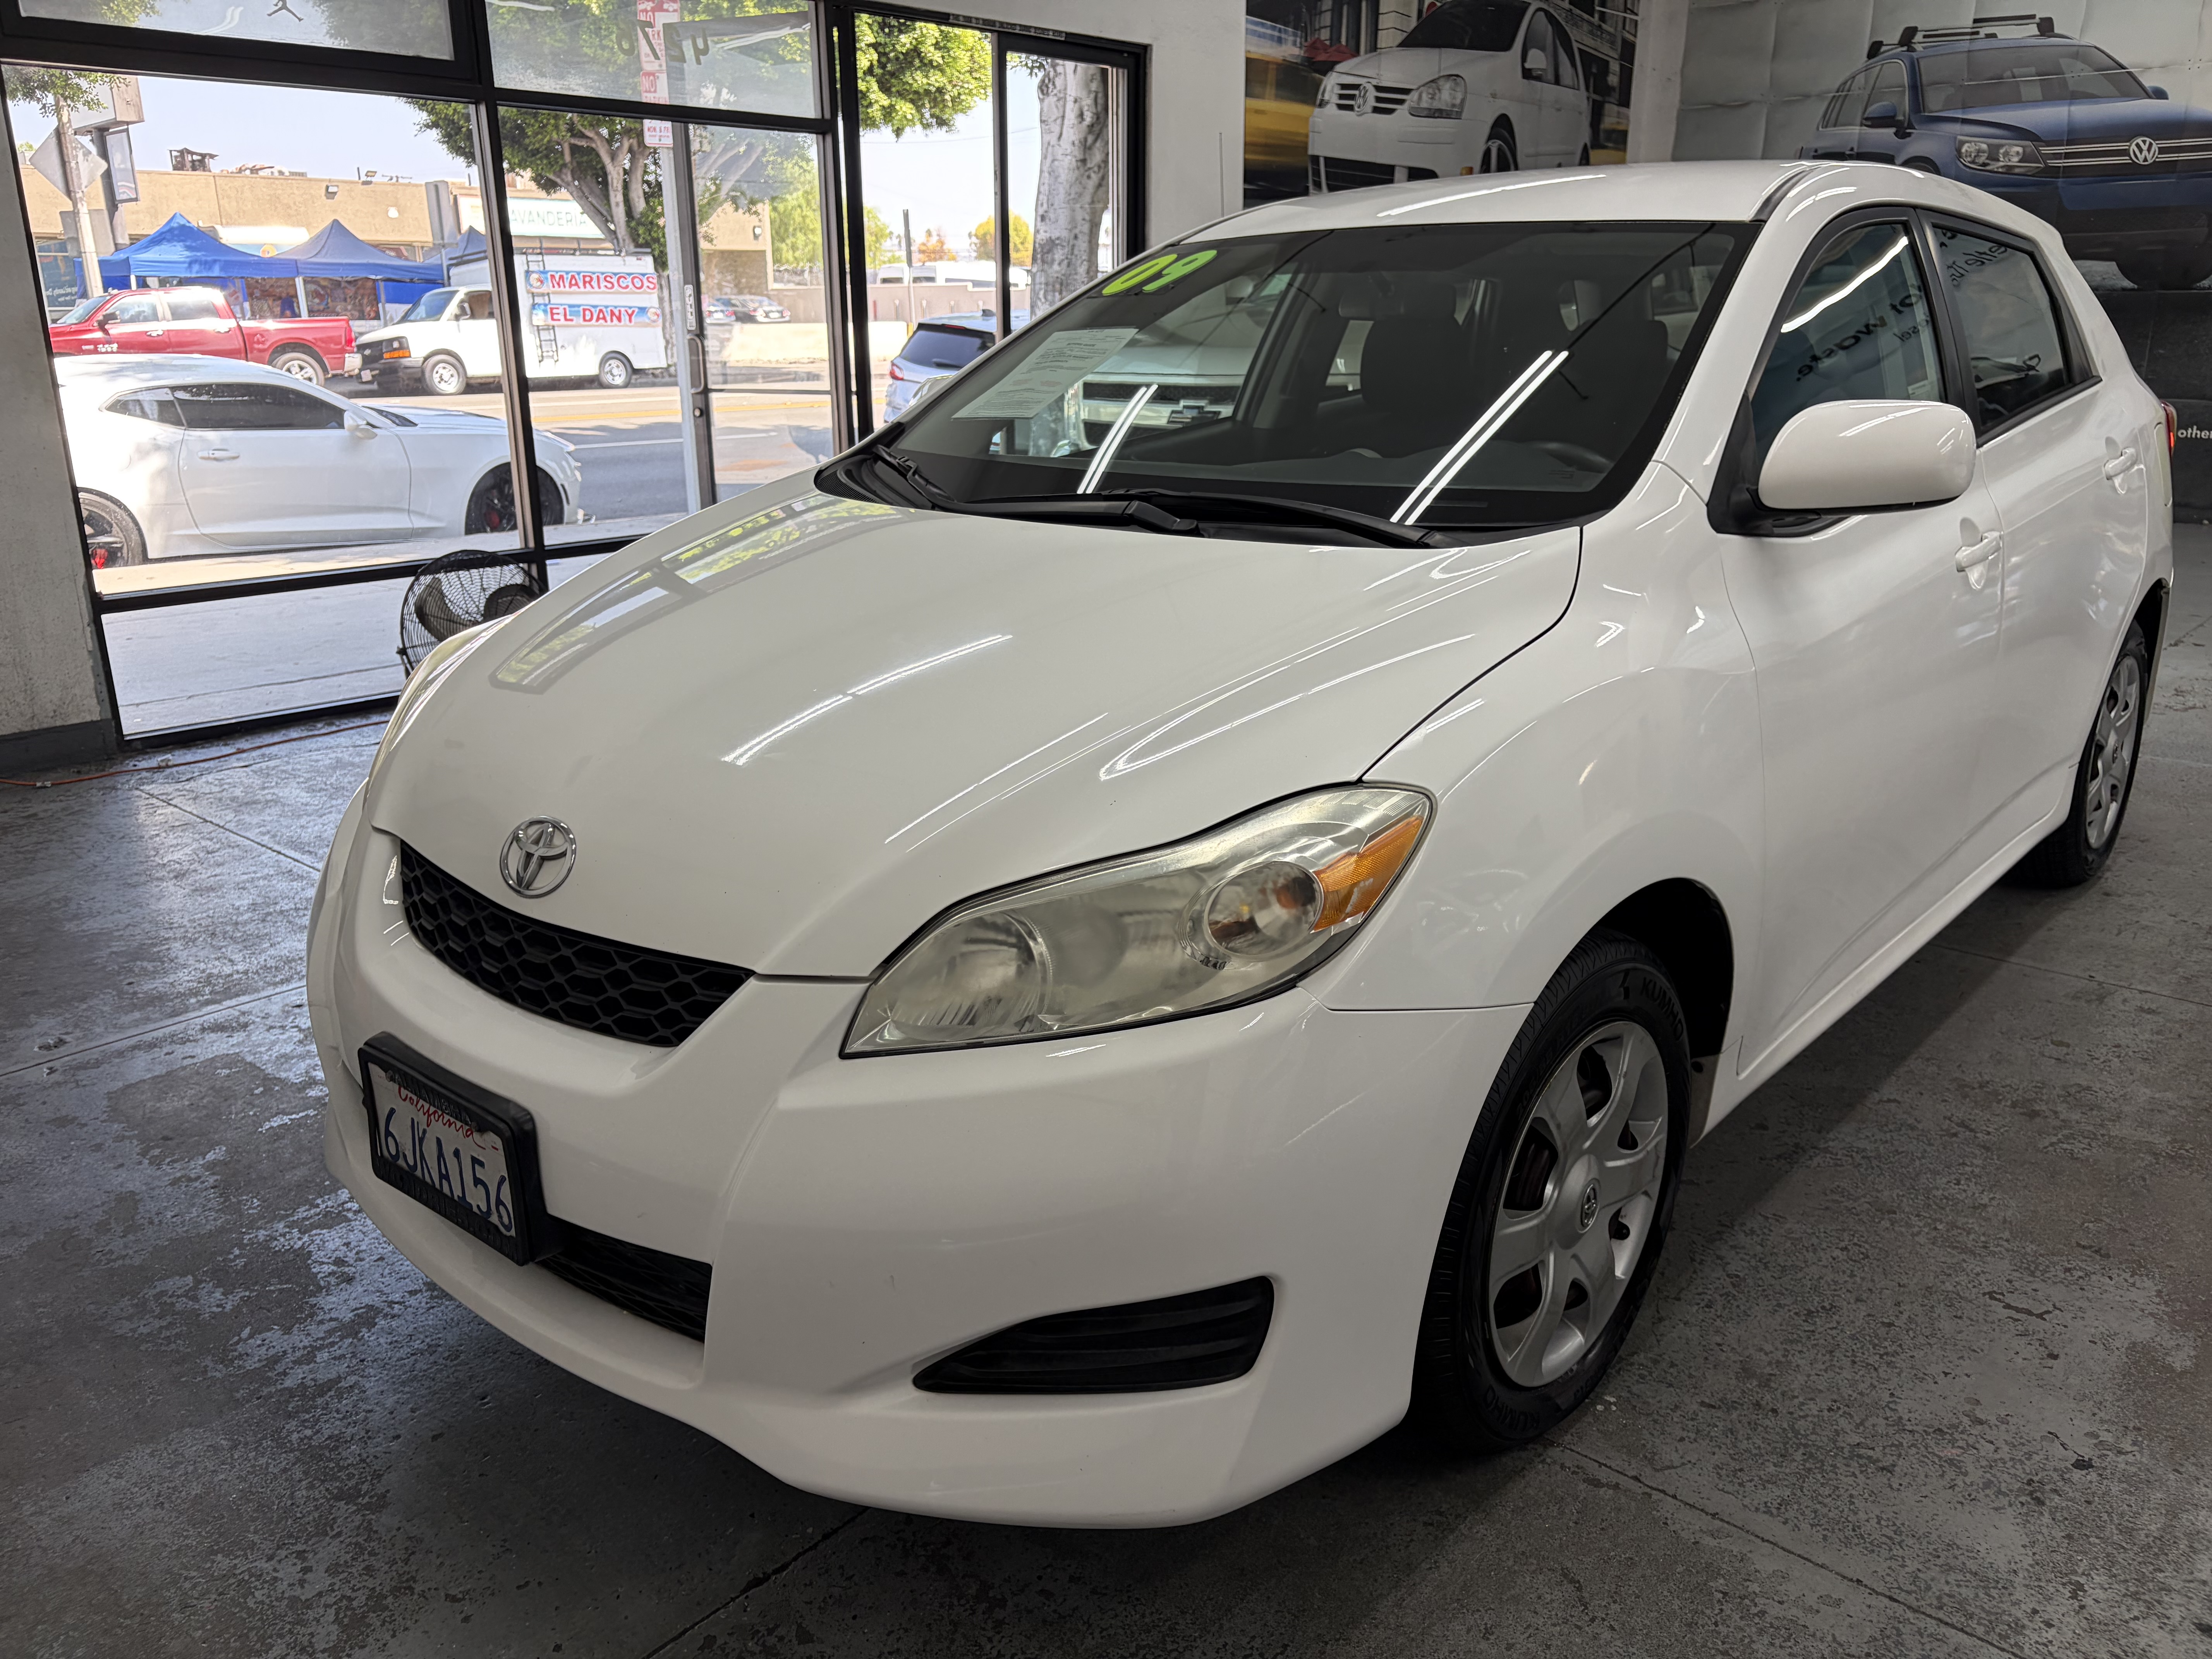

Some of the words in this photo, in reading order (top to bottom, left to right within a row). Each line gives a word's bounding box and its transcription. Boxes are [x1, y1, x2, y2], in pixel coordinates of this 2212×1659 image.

[642, 76, 656, 92] NO
[511, 208, 587, 227] AVANDERÍA
[549, 273, 657, 291] MARISCOS
[1102, 250, 1218, 296] 09
[549, 307, 574, 322] EL
[582, 307, 637, 324] DANY
[685, 287, 694, 320] PULL
[1640, 976, 1685, 1041] KUMHO
[398, 1086, 486, 1150] California
[383, 1106, 513, 1233] 6JKA156
[1484, 1384, 1541, 1432] KUMHO
